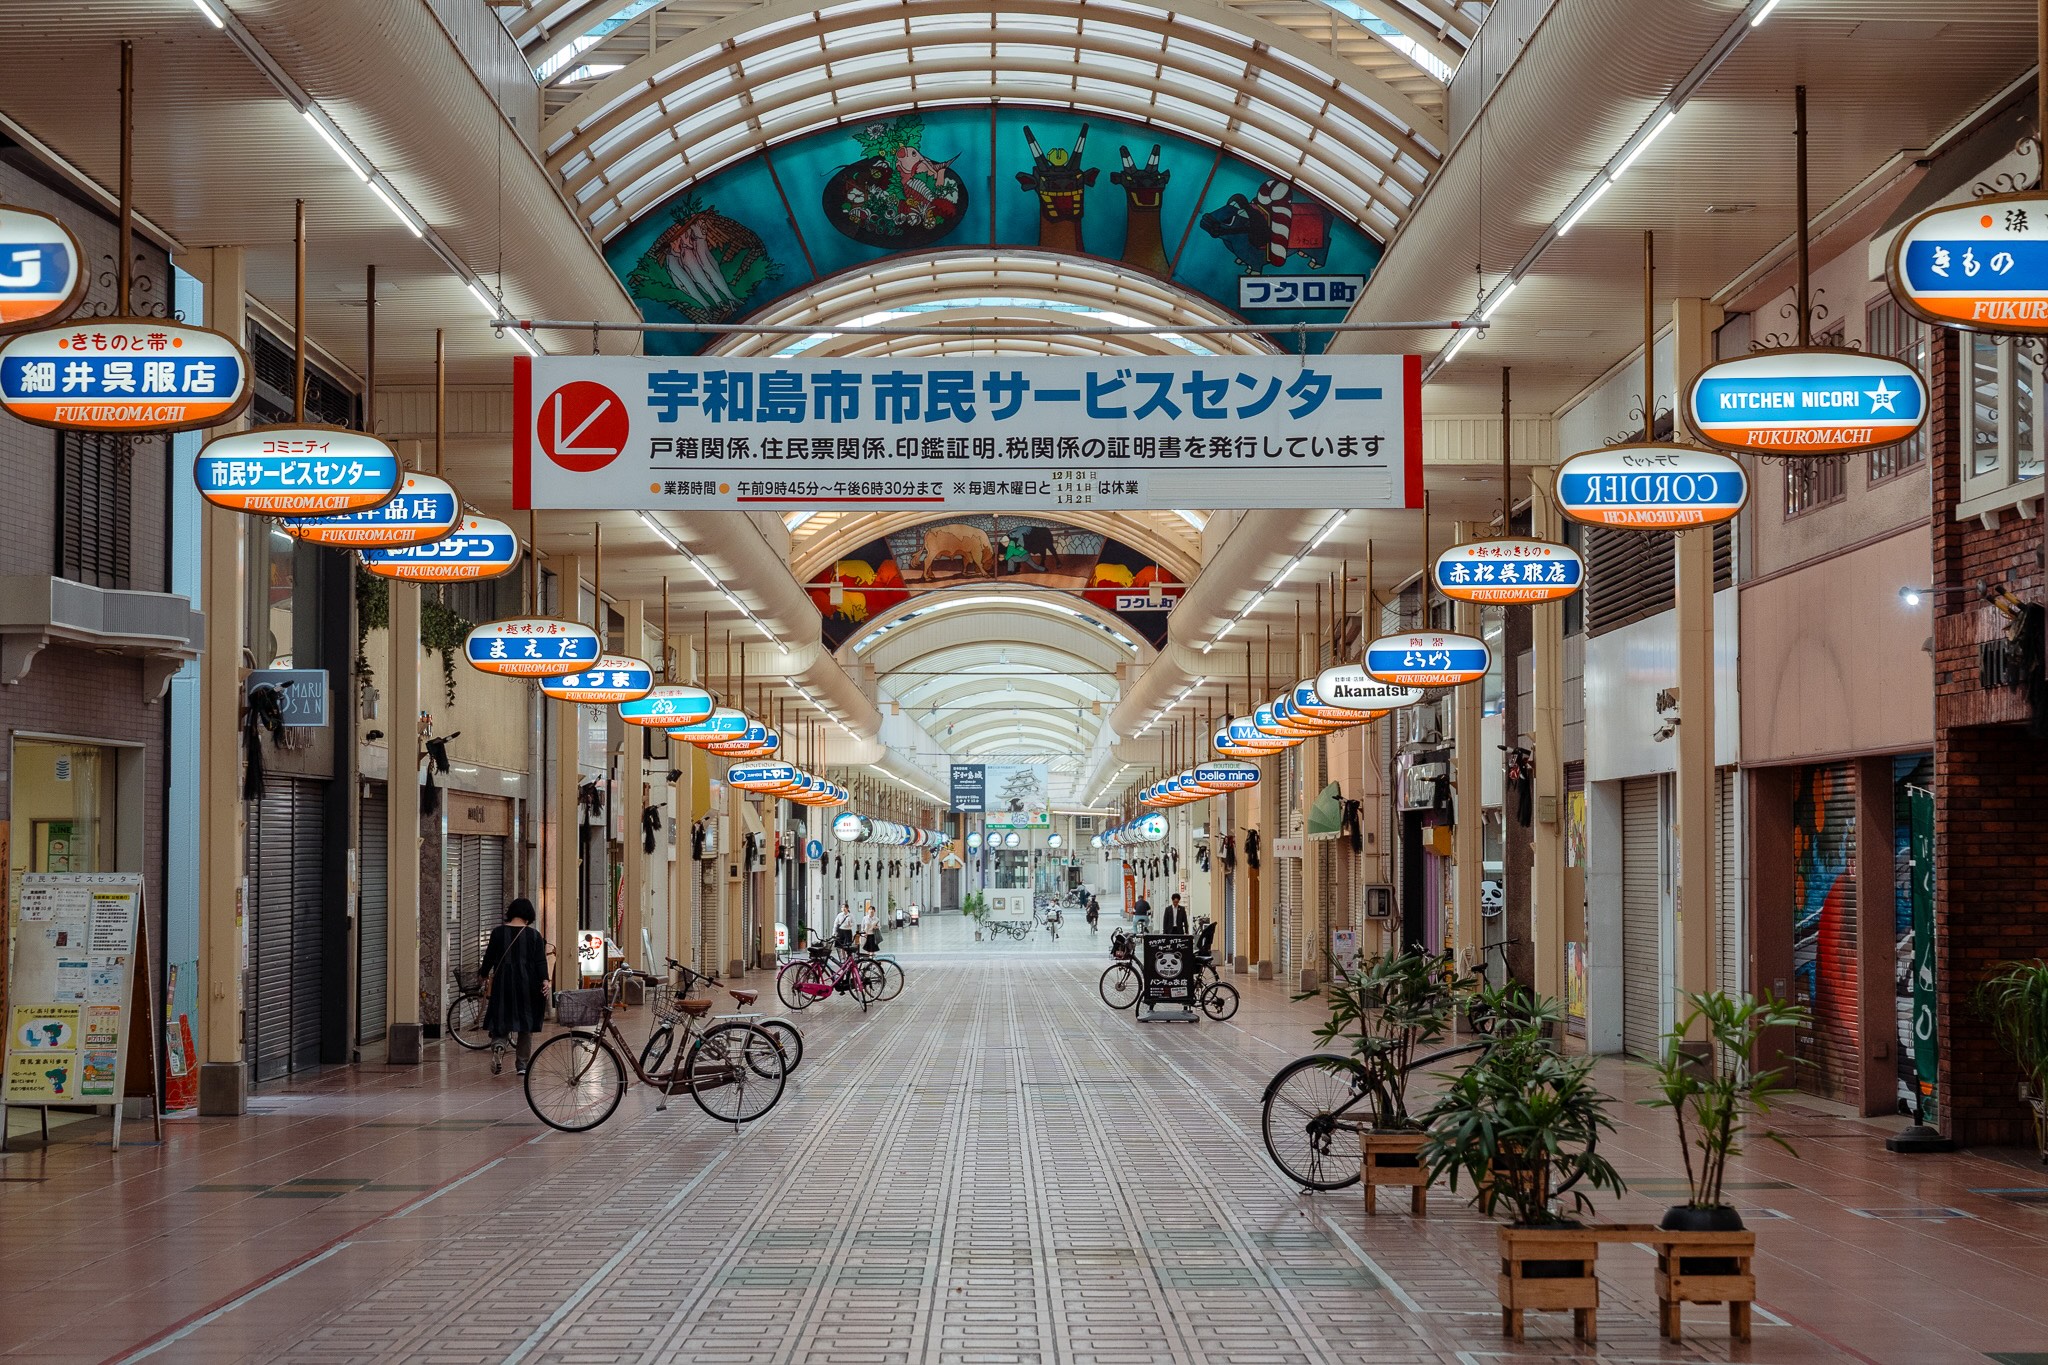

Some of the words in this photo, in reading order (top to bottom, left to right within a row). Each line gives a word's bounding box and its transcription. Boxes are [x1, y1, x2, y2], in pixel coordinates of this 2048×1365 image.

[1931, 246, 2015, 278] きもの
[1246, 281, 1357, 302] フクロ町
[1972, 301, 2048, 320] FUKUR
[71, 333, 168, 351] きものと帯
[20, 361, 216, 393] 細井呉服店
[648, 369, 862, 424] 宇和島市
[872, 368, 1382, 424] 市民サービスセンター
[1719, 392, 1795, 409] KITCHEN
[1802, 391, 1859, 407] NICORI
[1876, 394, 1889, 403] 25
[54, 406, 186, 422] FUKUROMACHI
[1747, 428, 1873, 445] FUKUROMACHI
[263, 440, 330, 453] コミニティ
[211, 461, 381, 486] 市民サービスセンター
[1052, 471, 1097, 479] 12月31日
[664, 480, 716, 495] 業務時間
[1057, 483, 1092, 491] 1月1日
[1098, 480, 1139, 495] は休業
[244, 496, 350, 509] FUKUROMACHI
[1057, 495, 1092, 504] 1月2日
[320, 529, 416, 541] FUKUROMACHI
[395, 565, 480, 577] FUKUROMACHI
[1450, 562, 1566, 584] 赤松呉服店
[1471, 589, 1549, 599] FUKUROMACHI
[506, 624, 558, 635] 趣味の店
[489, 638, 578, 659] まえだ
[498, 662, 570, 673] FUKUROMACHI
[562, 672, 630, 687] あづま
[1395, 674, 1462, 683] FUKUROMACHI
[292, 682, 322, 698] MARU
[565, 692, 626, 701] FUKUROMACHI
[1334, 685, 1409, 698] Akamatsu
[292, 699, 322, 714] SAN
[641, 716, 692, 725] FUKUROMACHI
[1200, 771, 1226, 780] belle
[1229, 771, 1255, 780] mine
[26, 875, 138, 883] 市民サービスセンター
